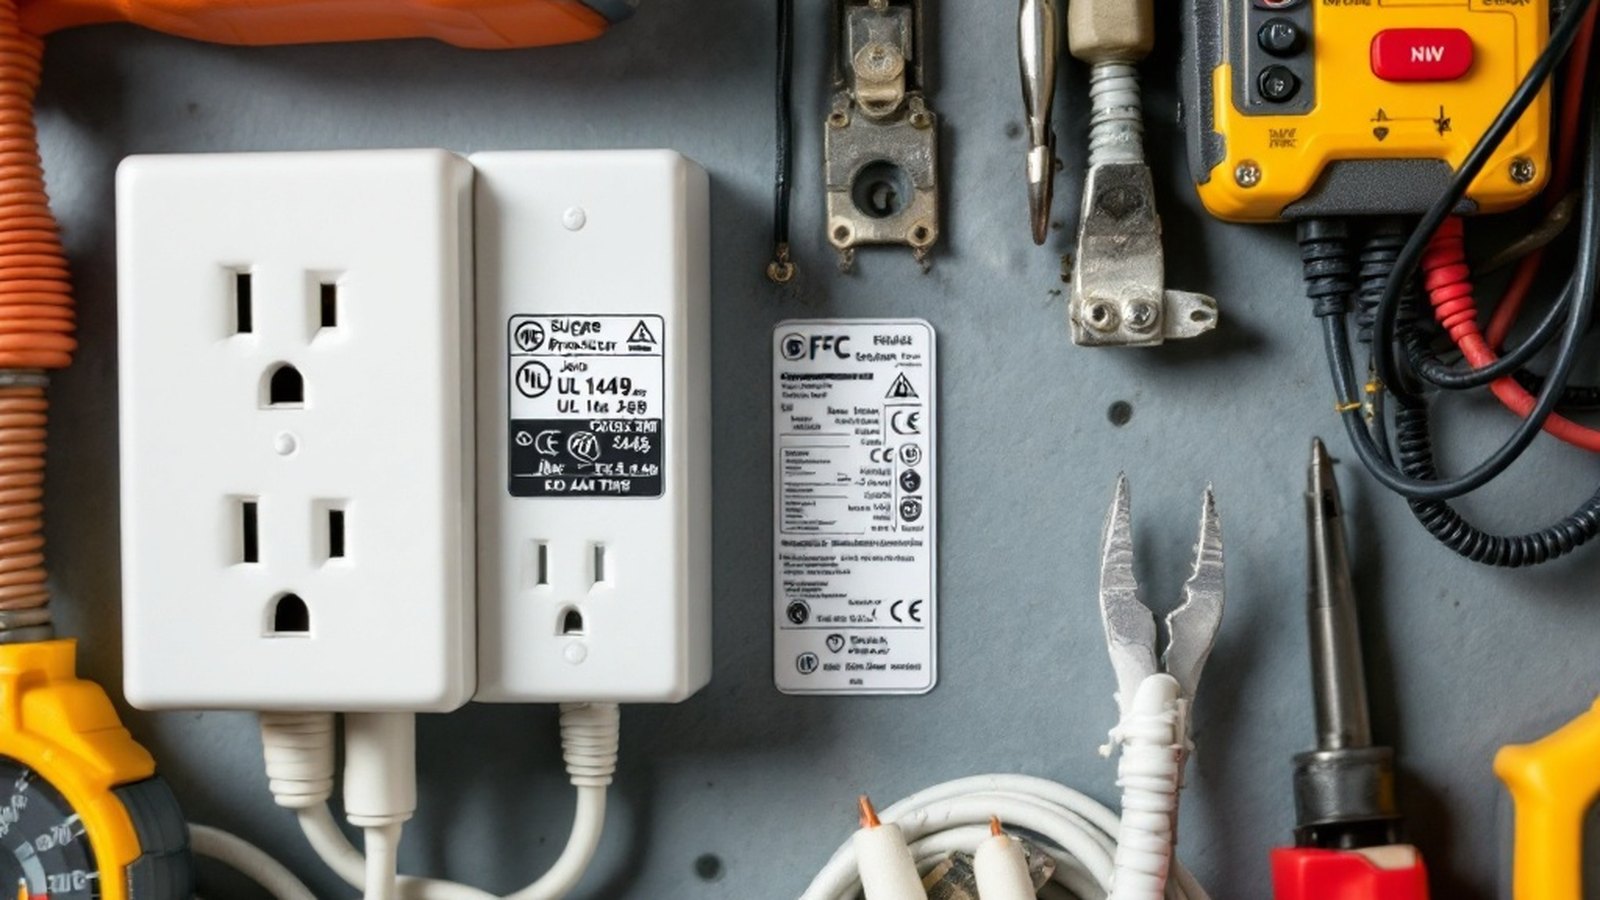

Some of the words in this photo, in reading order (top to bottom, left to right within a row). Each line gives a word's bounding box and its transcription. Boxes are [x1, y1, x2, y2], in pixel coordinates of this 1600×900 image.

[557, 377, 580, 395] UL
[586, 376, 632, 397] 1449
[557, 399, 580, 413] UL
[890, 599, 923, 623] CE
